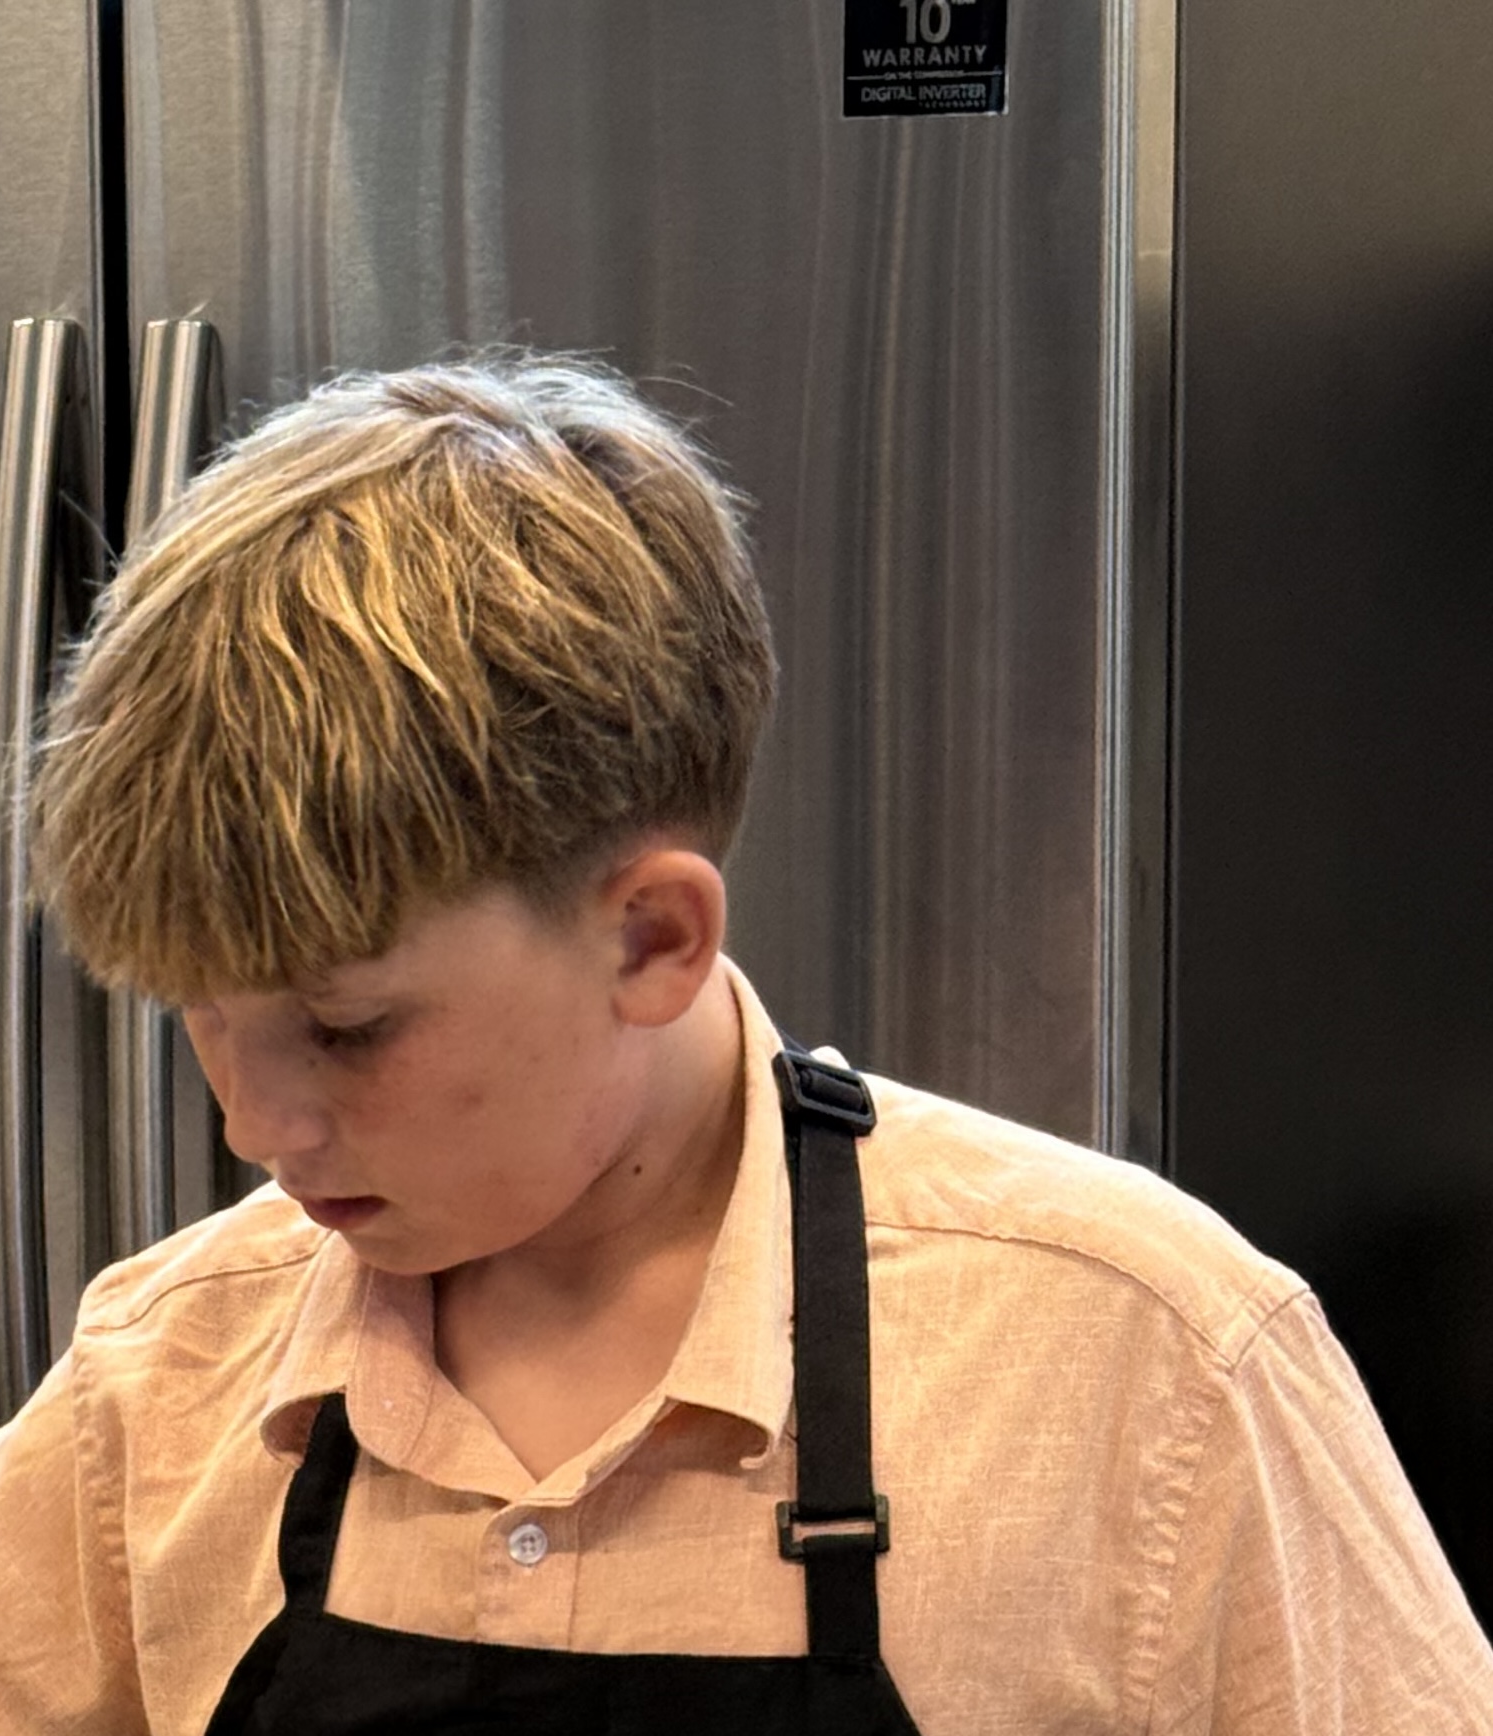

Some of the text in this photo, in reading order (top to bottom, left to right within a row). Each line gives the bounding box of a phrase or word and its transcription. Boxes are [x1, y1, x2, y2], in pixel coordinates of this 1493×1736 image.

[899, 0, 952, 44] 10
[862, 45, 987, 68] WARRANTY
[861, 83, 987, 102] DIGITAL INVERTER
